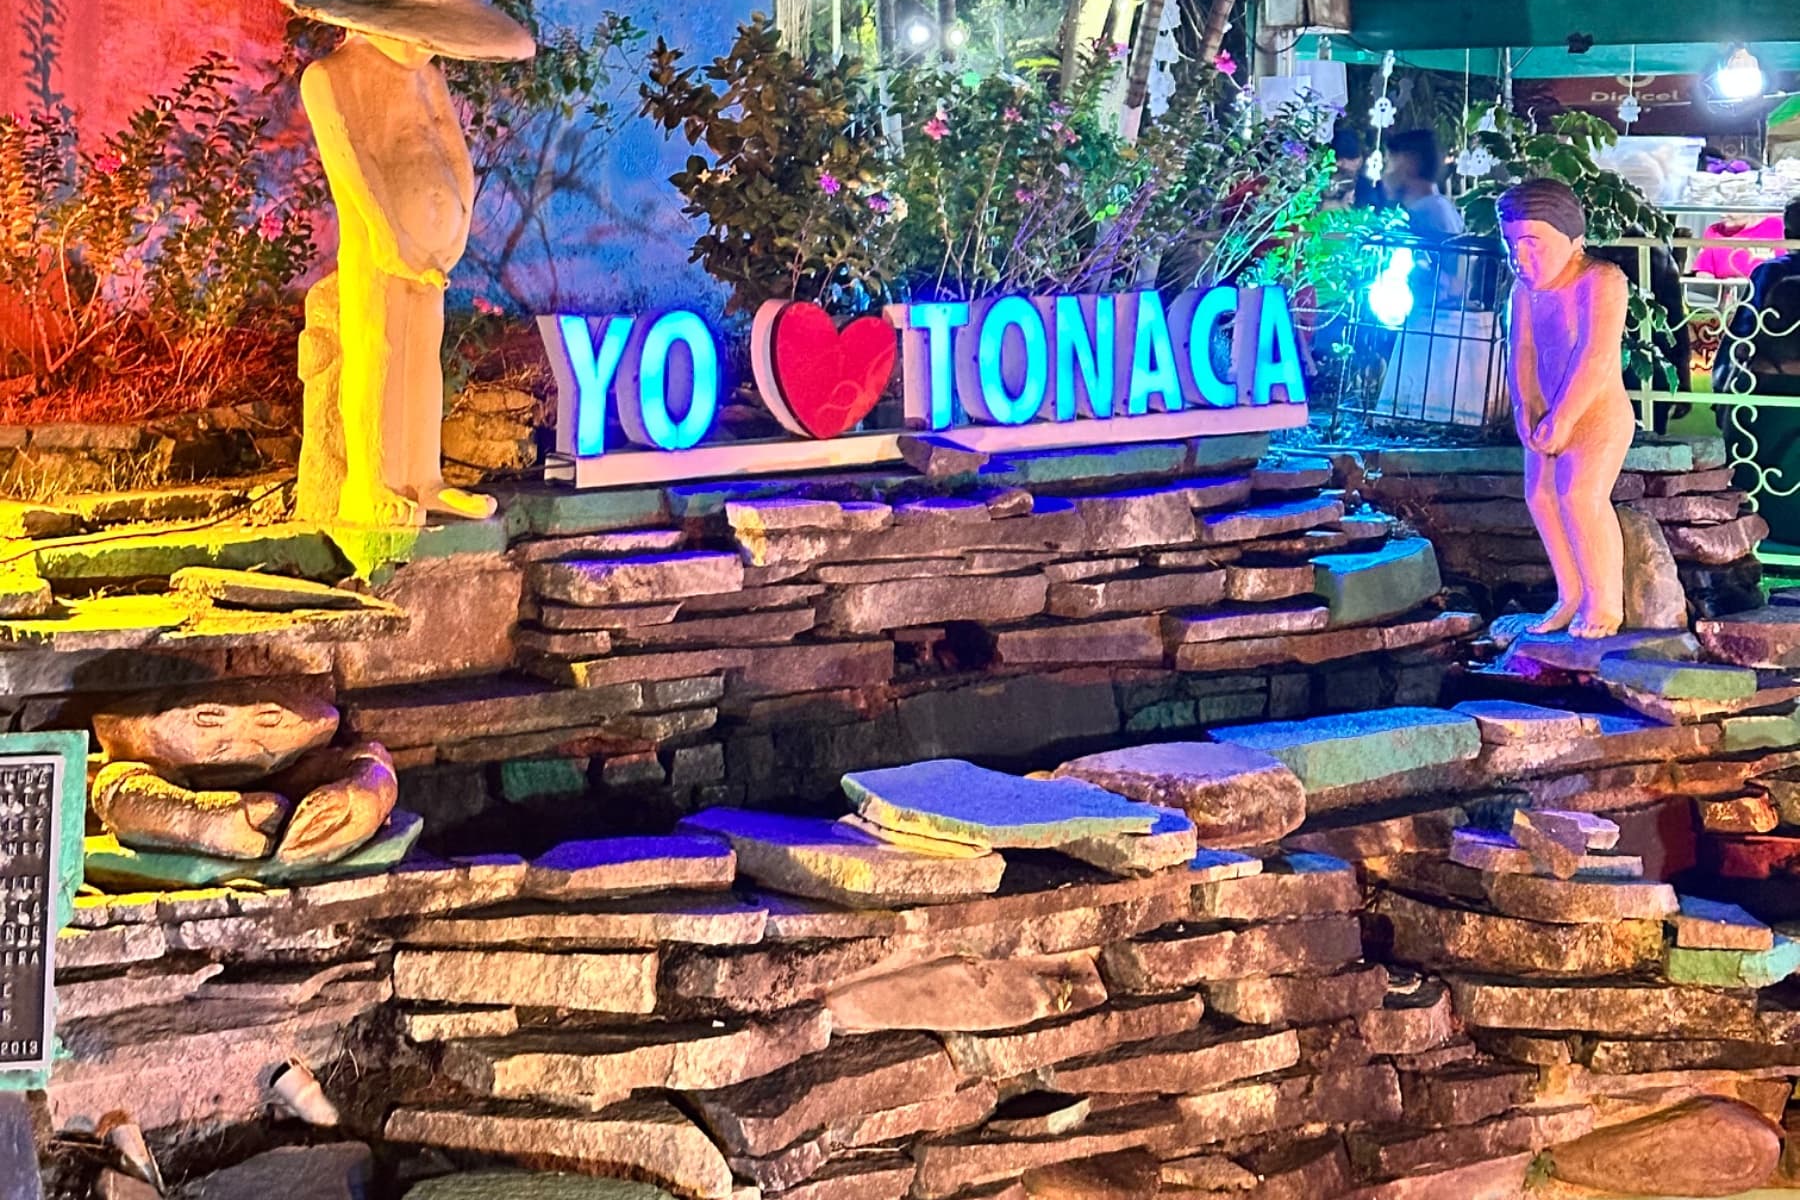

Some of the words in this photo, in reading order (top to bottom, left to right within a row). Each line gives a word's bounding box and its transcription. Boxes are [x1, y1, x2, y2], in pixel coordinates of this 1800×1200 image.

[556, 309, 718, 458] YO
[907, 285, 1308, 432] TONACA
[0, 817, 44, 833] LEZ
